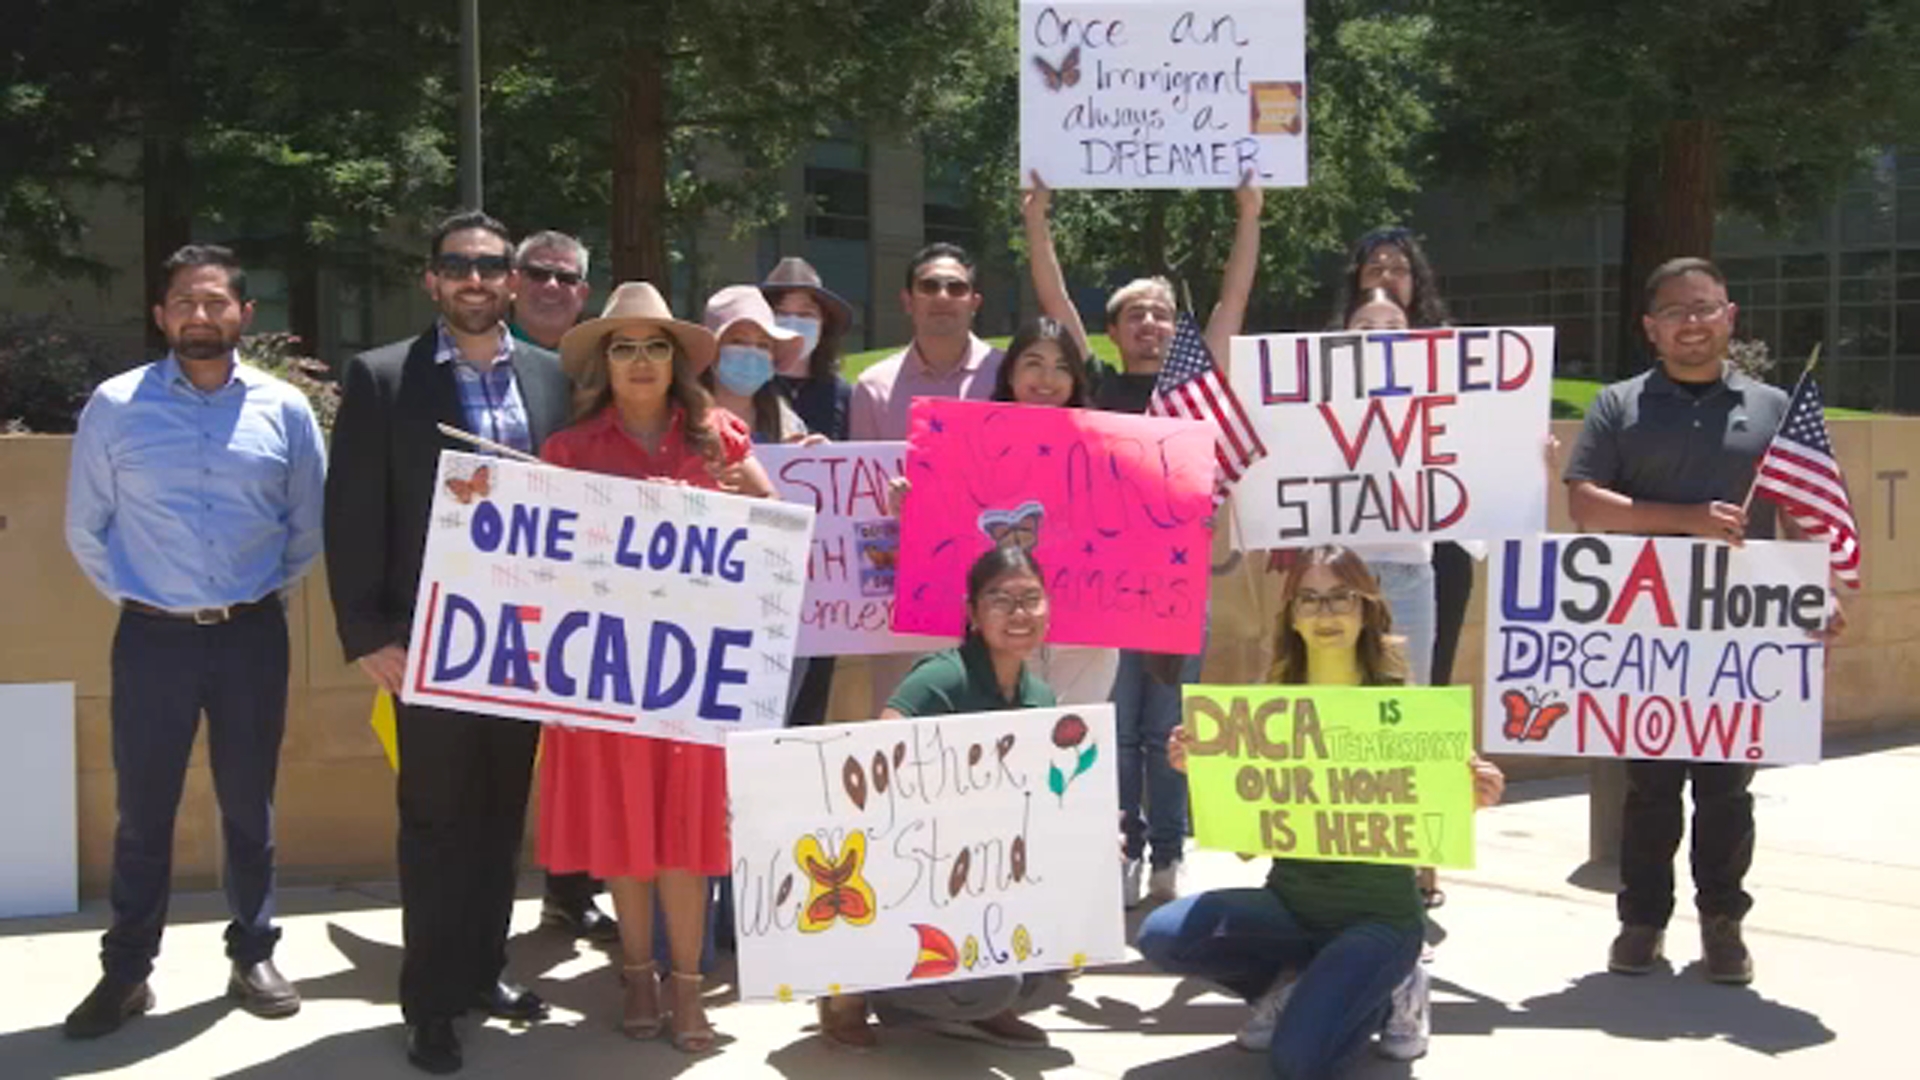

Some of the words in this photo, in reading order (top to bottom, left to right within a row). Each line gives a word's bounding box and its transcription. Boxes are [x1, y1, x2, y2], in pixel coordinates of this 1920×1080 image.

[1034, 7, 1130, 48] Once
[1170, 11, 1249, 47] an
[1062, 95, 1166, 139] always
[1193, 105, 1229, 132] a
[1096, 57, 1248, 114] Immigrant
[1080, 137, 1274, 179] DREAMER
[1258, 329, 1534, 405] UNITED
[1317, 395, 1458, 471] WE
[1277, 468, 1469, 539] STAND
[470, 500, 579, 561] ONE
[615, 515, 748, 583] LONG
[1501, 537, 1678, 628] USA
[1687, 543, 1826, 631] Home
[1496, 626, 1690, 697] DREAM
[1709, 640, 1823, 702] ACT
[1186, 695, 1329, 761] DACA
[1379, 699, 1402, 725] IS
[1577, 692, 1763, 760] NOW!
[1235, 765, 1320, 805] OUR
[1326, 766, 1419, 805] HOME
[1259, 810, 1297, 852] IS
